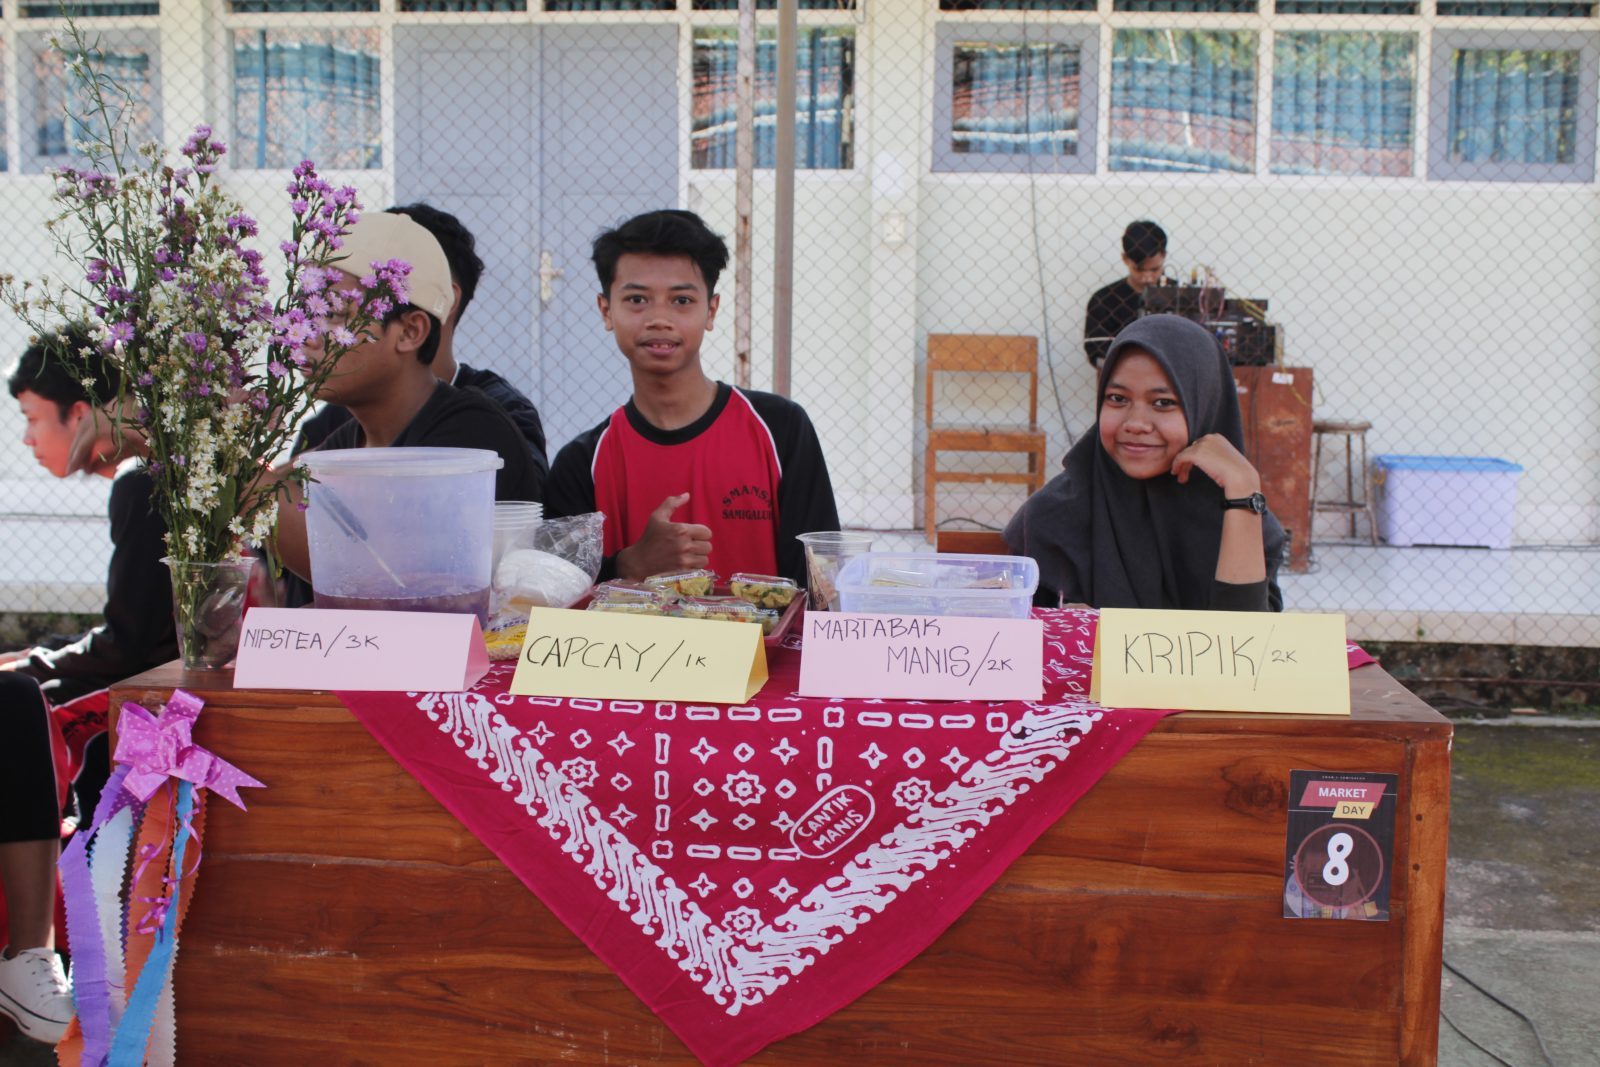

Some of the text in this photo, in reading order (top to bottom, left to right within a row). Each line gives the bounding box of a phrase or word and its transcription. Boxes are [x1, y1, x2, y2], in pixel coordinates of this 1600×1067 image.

[813, 617, 941, 641] MARTABAK
[1318, 787, 1368, 798] MARKET
[797, 791, 854, 837] CANTIK
[1342, 805, 1366, 816] DAY
[812, 809, 864, 851] MANIS
[1322, 832, 1354, 886] 8
